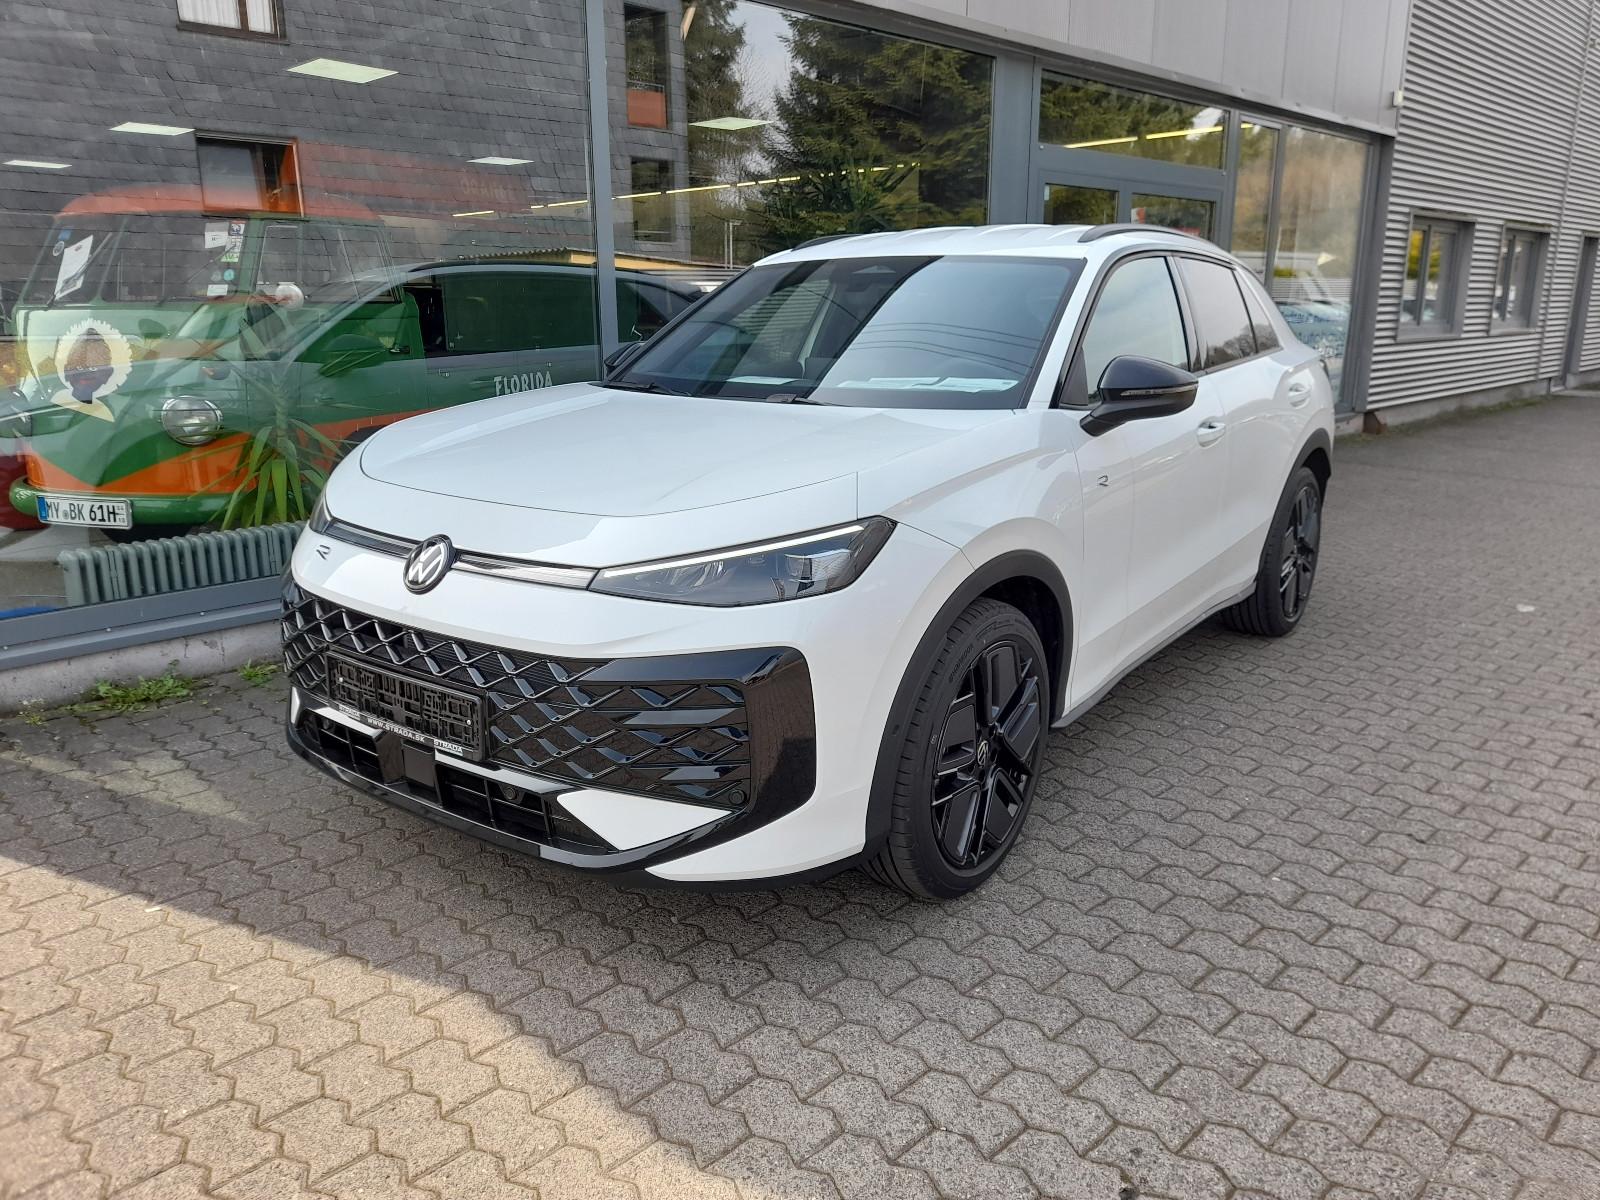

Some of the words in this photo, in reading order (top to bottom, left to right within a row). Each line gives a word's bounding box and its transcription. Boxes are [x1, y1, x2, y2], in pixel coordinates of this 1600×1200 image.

[493, 371, 553, 396] FLORIDA
[46, 501, 60, 519] MY
[69, 503, 86, 521] BK
[89, 504, 117, 523] 61H
[367, 718, 425, 743] WWW.STRADA.SK
[433, 740, 463, 753] STRADA
